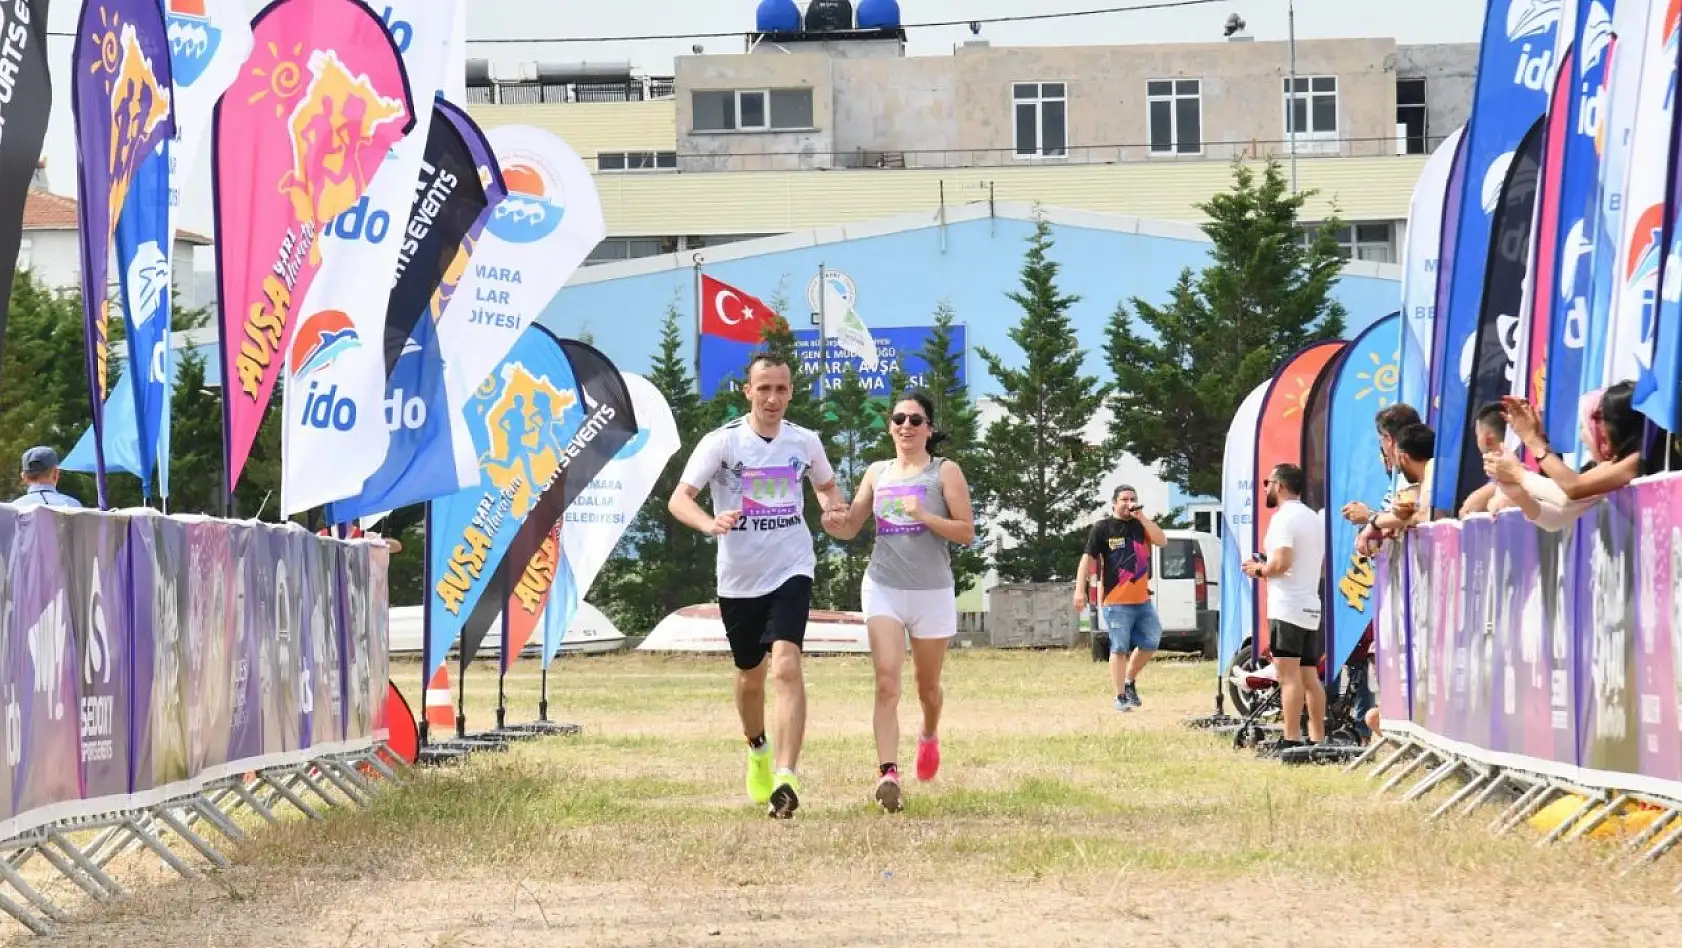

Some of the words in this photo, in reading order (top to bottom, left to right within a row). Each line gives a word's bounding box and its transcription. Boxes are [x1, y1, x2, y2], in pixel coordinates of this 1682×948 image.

[1514, 43, 1553, 92] id
[1578, 82, 1604, 137] id
[300, 381, 356, 431] ido
